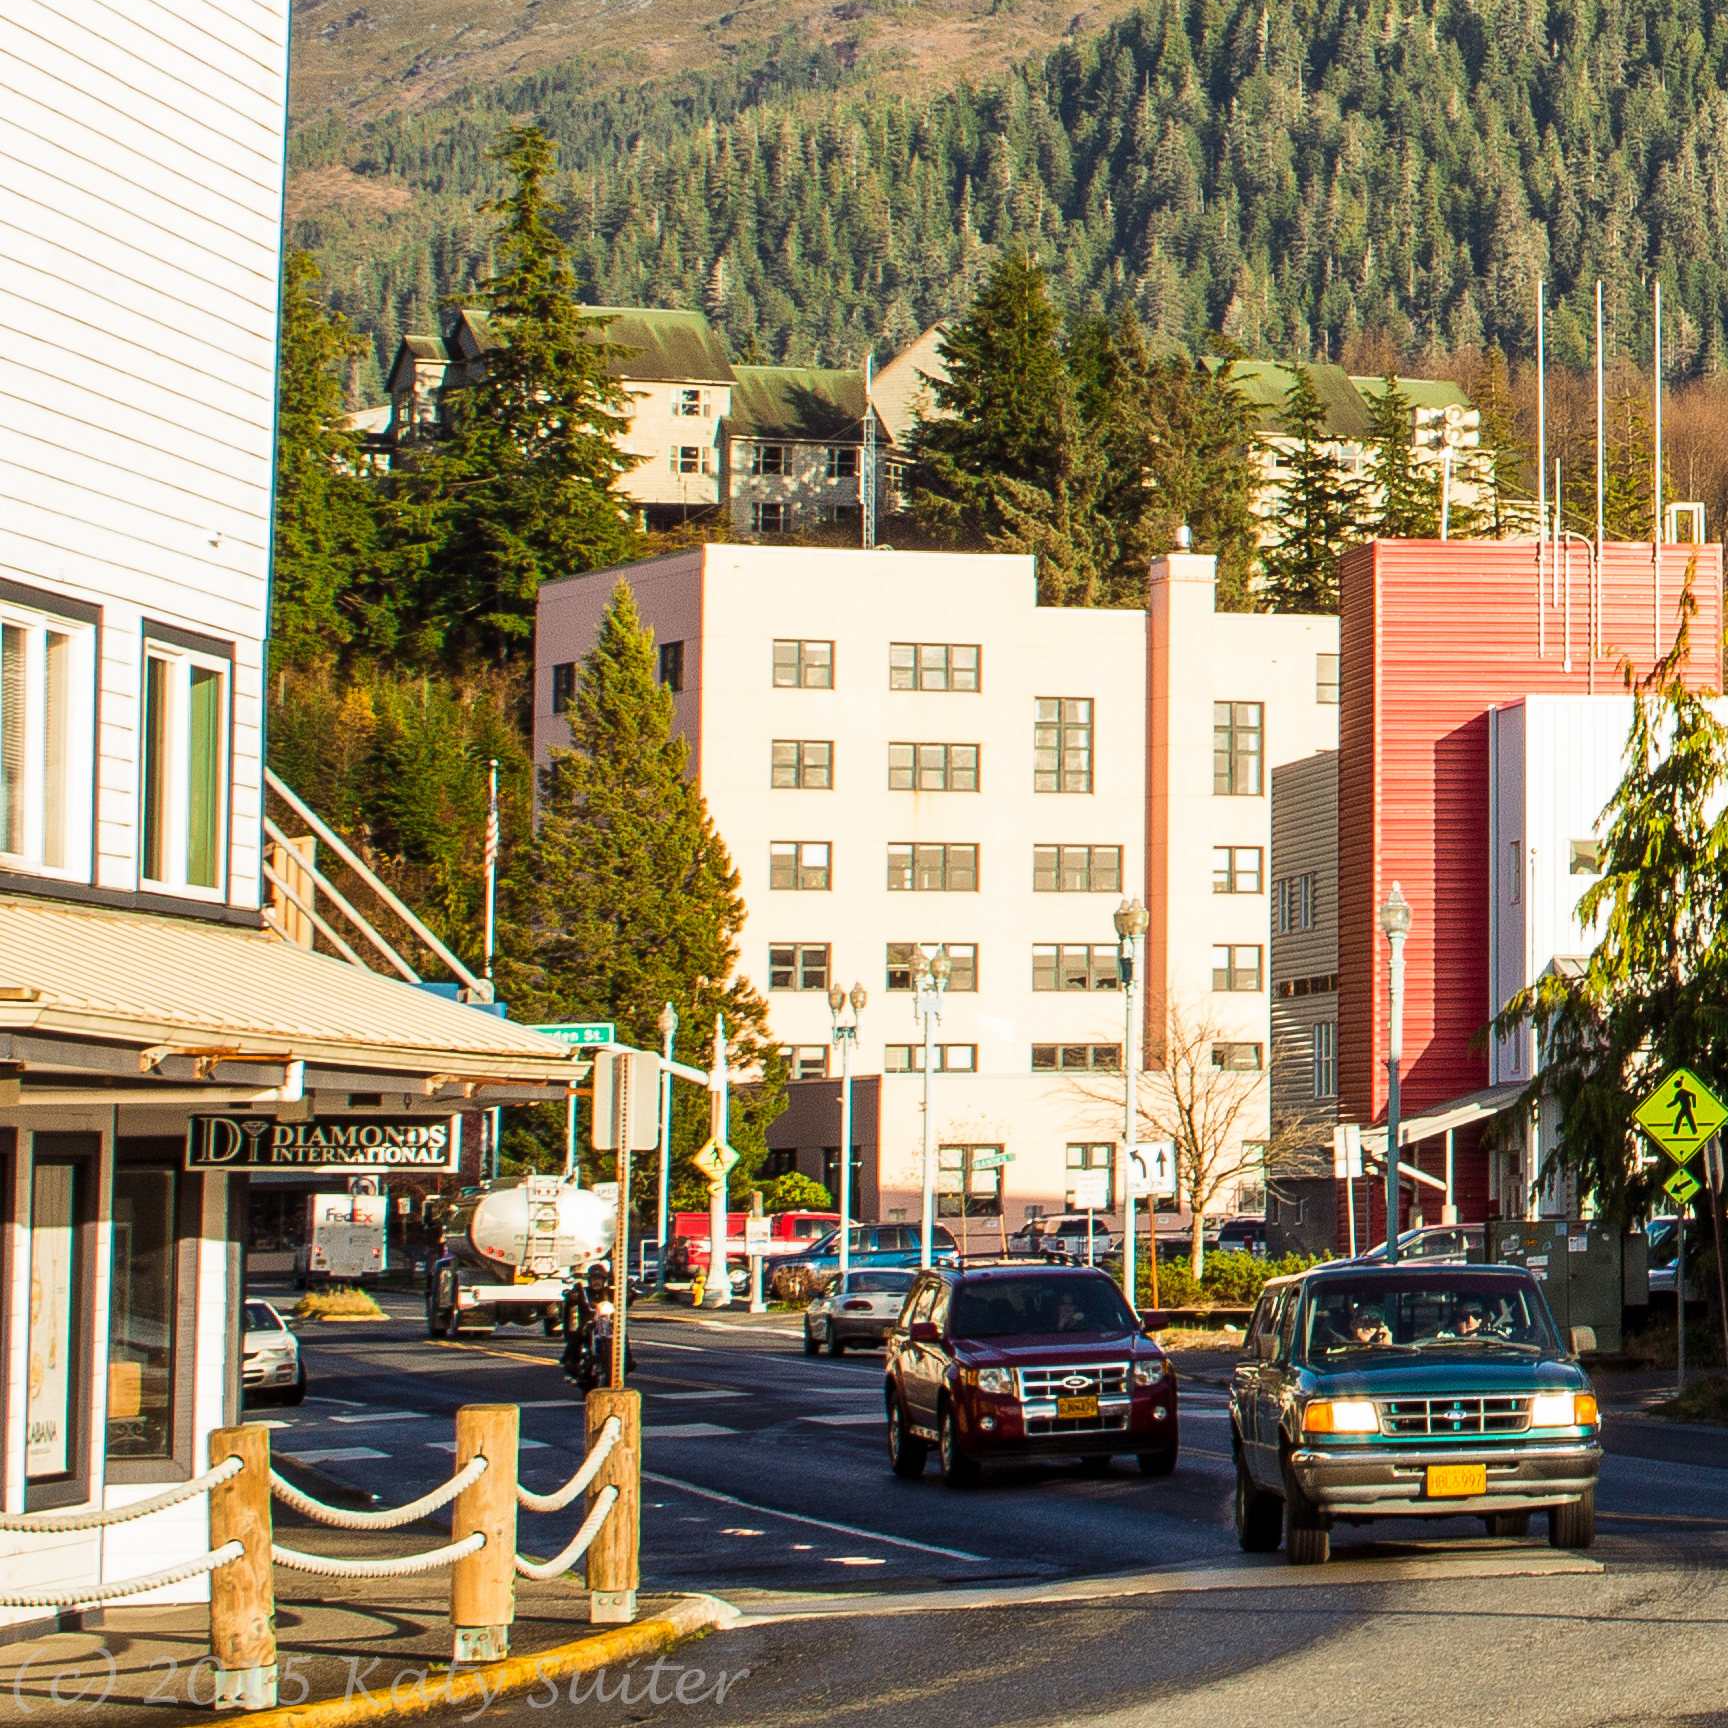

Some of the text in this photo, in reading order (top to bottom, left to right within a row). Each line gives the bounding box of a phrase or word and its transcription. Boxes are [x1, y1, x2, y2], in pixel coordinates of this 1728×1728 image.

[271, 1124, 447, 1148] DIAMONDS
[271, 1146, 445, 1164] INTERNATIONAL
[326, 1207, 374, 1223] FedEx
[1461, 1473, 1483, 1487] 997
